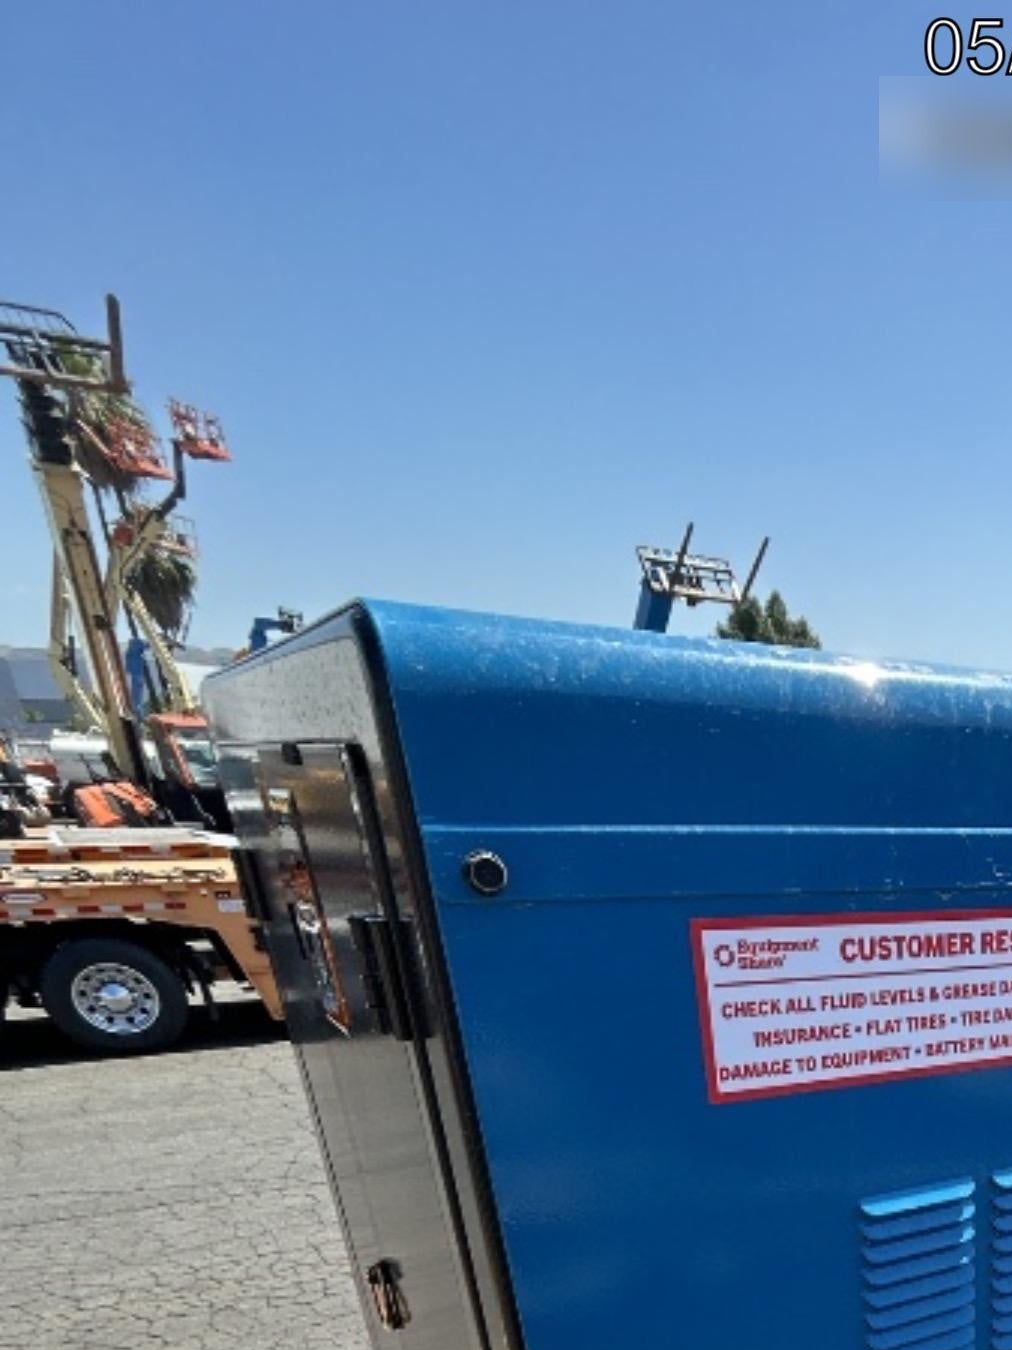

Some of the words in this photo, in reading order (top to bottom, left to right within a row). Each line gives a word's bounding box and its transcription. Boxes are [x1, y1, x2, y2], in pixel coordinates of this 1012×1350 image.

[840, 932, 975, 962] CUSTOMER
[721, 998, 783, 1019] CHECK
[785, 996, 816, 1013] ALL
[820, 992, 868, 1011] FLUID
[870, 987, 925, 1006] LEVELS
[942, 980, 996, 1000] GREASE
[753, 1023, 852, 1047] INSURANCE
[866, 1016, 902, 1036] FLAT
[906, 1013, 946, 1033] TIRES
[960, 1009, 991, 1026] TIRE
[719, 1058, 793, 1081] DAMAGE
[795, 1055, 816, 1072] TO
[822, 1046, 911, 1070] EQUIPMENT
[925, 1037, 985, 1057] BATTERY
